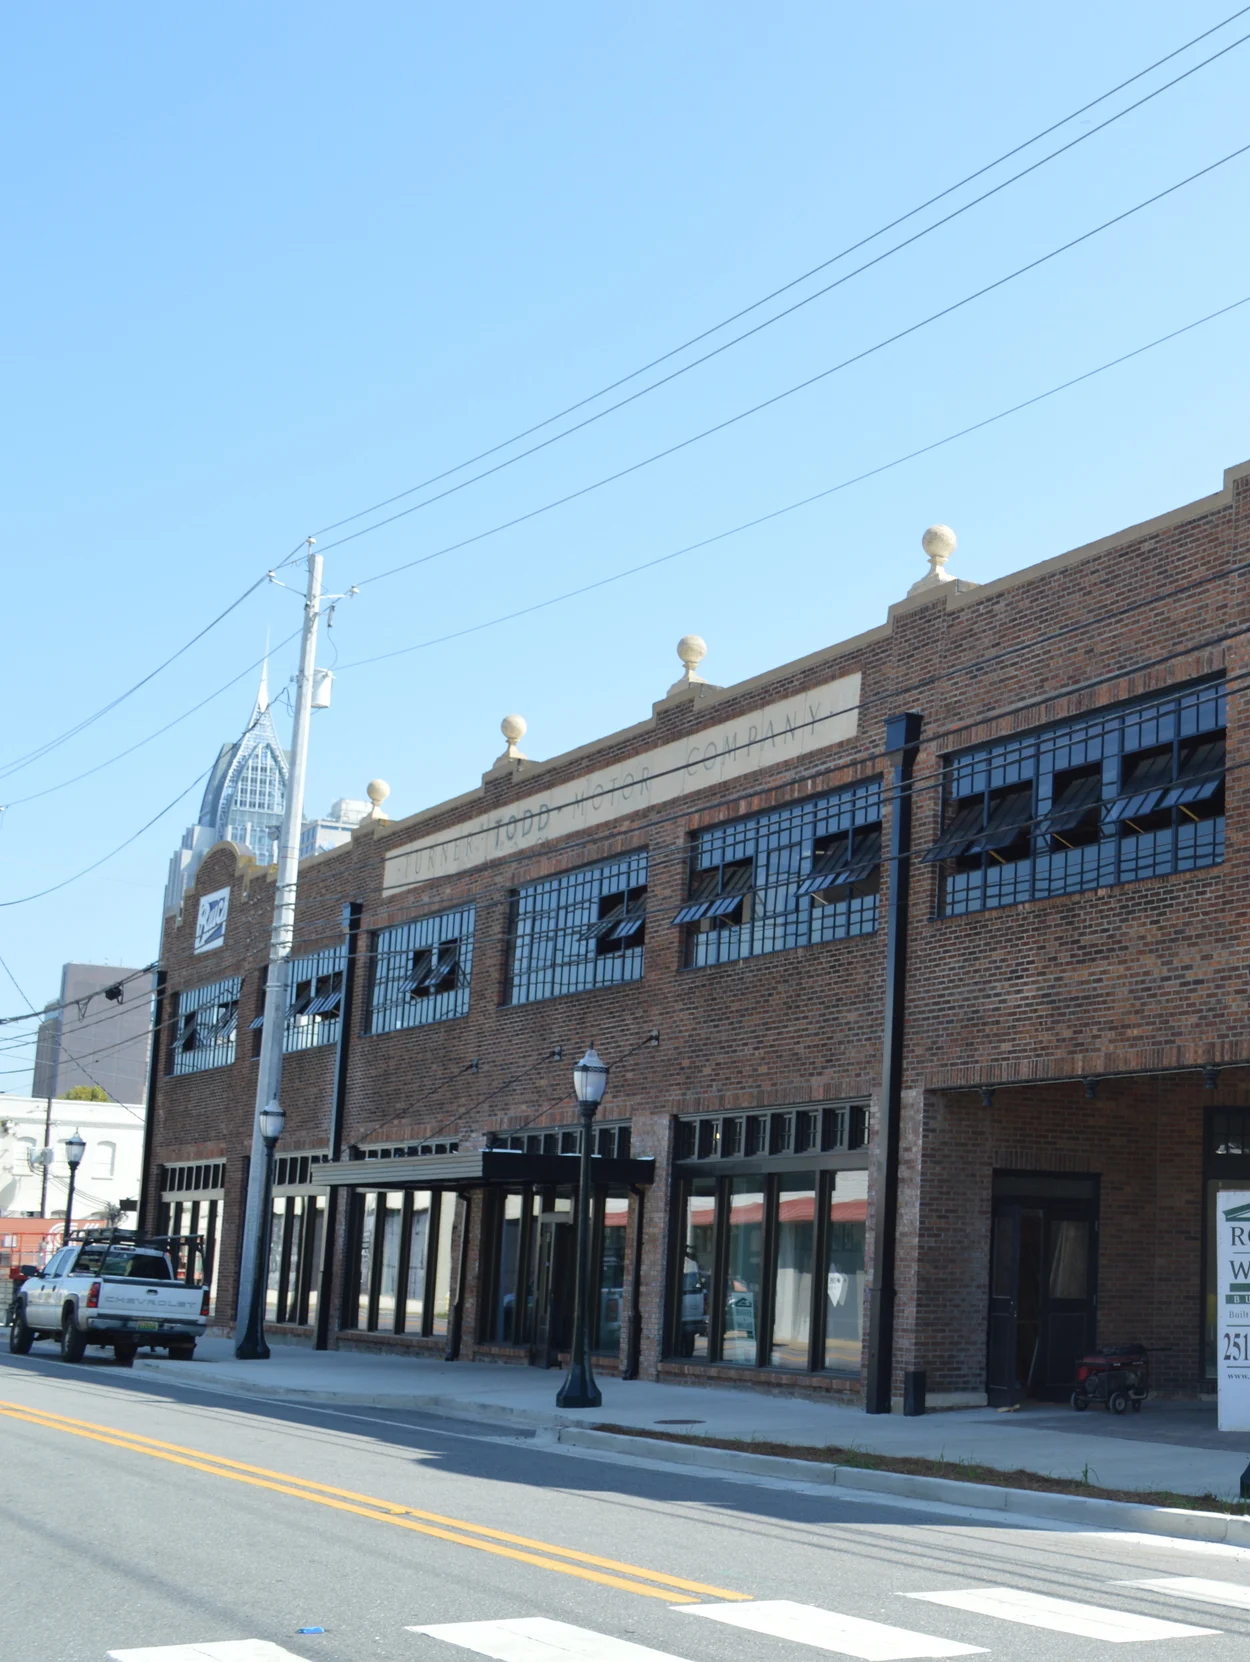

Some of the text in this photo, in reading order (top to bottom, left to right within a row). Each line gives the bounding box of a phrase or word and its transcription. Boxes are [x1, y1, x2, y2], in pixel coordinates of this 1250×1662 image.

[403, 702, 821, 878] TURNER TODD MOTOR COMPANY
[104, 1295, 197, 1309] CHEVROLET
[1228, 1310, 1249, 1319] Built
